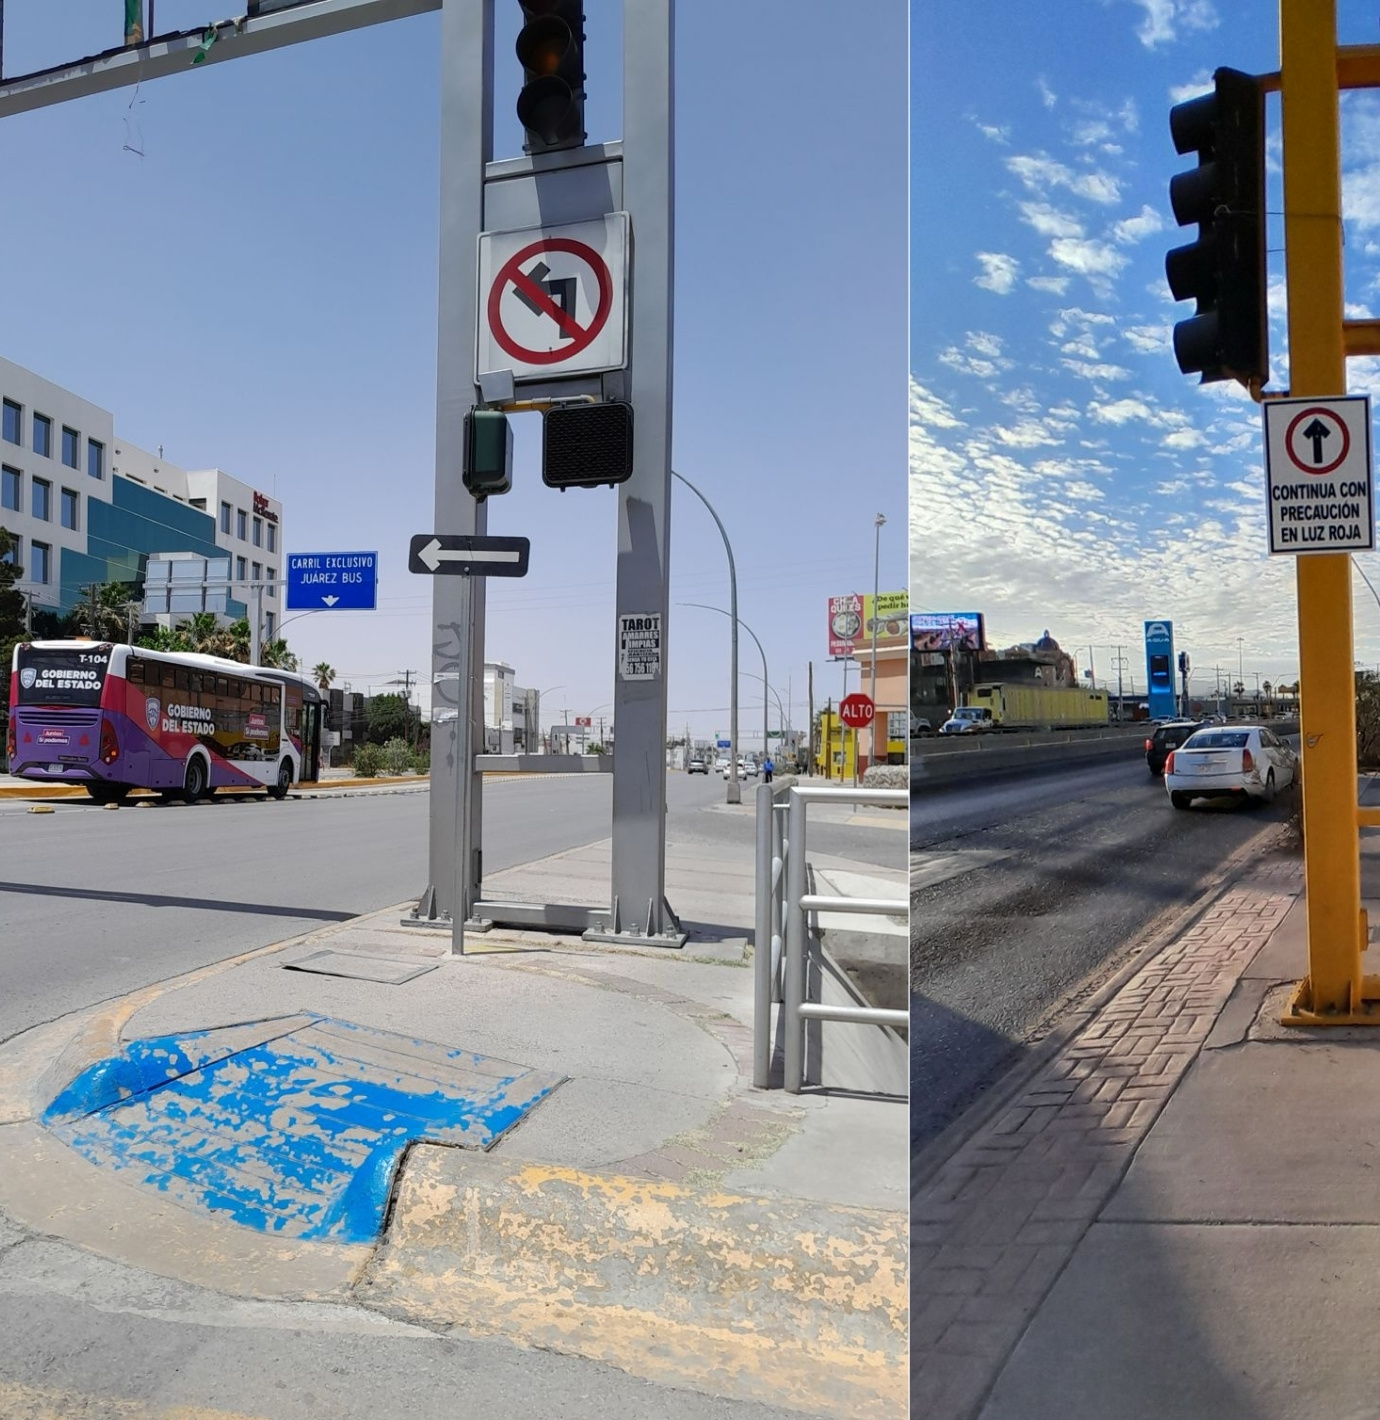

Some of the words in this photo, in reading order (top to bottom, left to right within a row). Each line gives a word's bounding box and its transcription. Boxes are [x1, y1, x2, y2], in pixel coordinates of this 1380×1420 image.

[1272, 483, 1337, 501] CONTINUA
[1339, 481, 1367, 498] CON
[1280, 501, 1360, 522] PRECAUCIÓN
[1281, 527, 1298, 543] EN
[1302, 526, 1325, 542] LUZ
[1329, 524, 1361, 541] ROJA
[291, 558, 321, 569] CARRIL
[326, 557, 373, 569] EXCLUSIVO
[300, 571, 337, 584] JUÁREZ
[342, 572, 363, 584] BUS
[878, 603, 899, 611] pedir
[621, 617, 660, 631] TAROT
[622, 631, 659, 640] AMARRES
[625, 639, 656, 649] IMPIAS
[79, 655, 108, 664] T-104
[41, 670, 97, 680] GOBIERNO
[35, 679, 55, 689] DEL
[57, 680, 102, 690] ESTADO
[167, 703, 211, 720] GOBIERNO
[842, 704, 873, 719] ALTO
[162, 719, 180, 732] DEL
[182, 720, 215, 735] ESTADO
